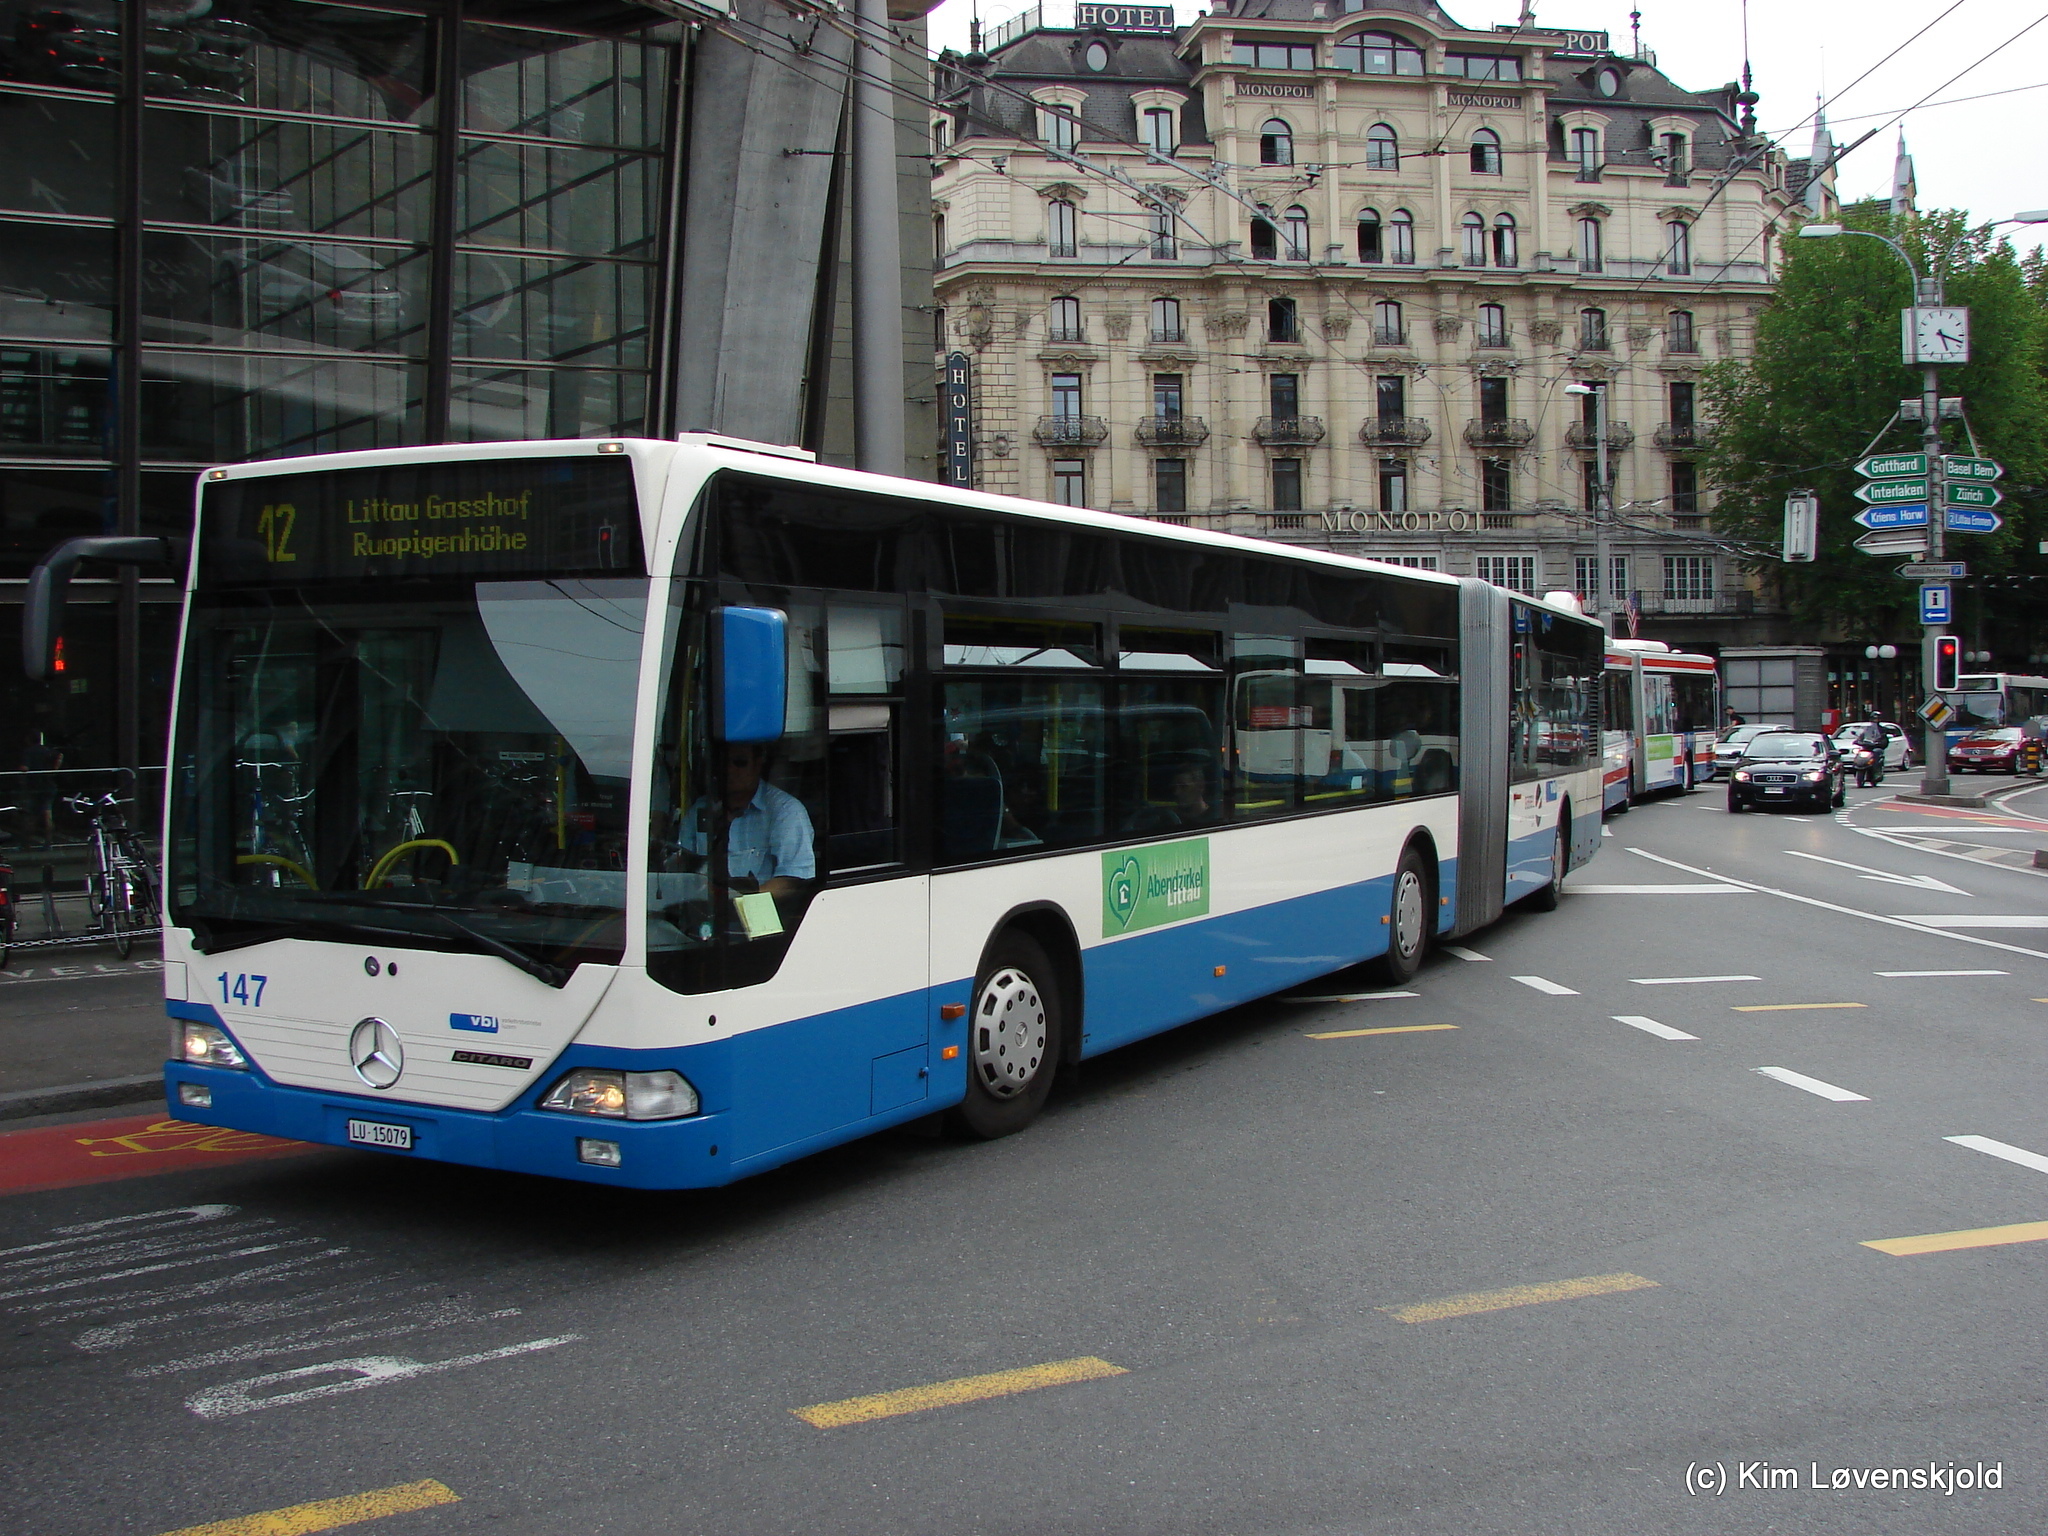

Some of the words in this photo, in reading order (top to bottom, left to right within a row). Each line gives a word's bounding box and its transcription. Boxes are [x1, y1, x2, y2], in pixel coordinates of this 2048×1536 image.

[1080, 6, 1173, 27] HOTEL
[1238, 84, 1313, 98] MONOPOL
[1449, 94, 1520, 109] MONOPOL
[952, 369, 967, 481] HOTEL
[1871, 458, 1918, 473] Gotthard
[1947, 461, 1971, 475] Basel
[1974, 463, 1994, 477] Bern
[1871, 485, 1923, 499] Interlaken
[1956, 487, 1983, 502] Zürich
[348, 499, 419, 523] Littau
[426, 489, 532, 520] Gasshof
[1320, 511, 1490, 532] MONOPOL
[1870, 511, 1897, 523] Kriens
[1900, 509, 1923, 521] Horw
[257, 503, 296, 562] 12
[353, 525, 527, 560] Ruopigenhöhe
[1147, 865, 1203, 899] Abendzirkel
[1167, 882, 1201, 906] Littau
[217, 971, 268, 1008] 147
[470, 1016, 498, 1029] vbl
[454, 1052, 530, 1068] CITARO
